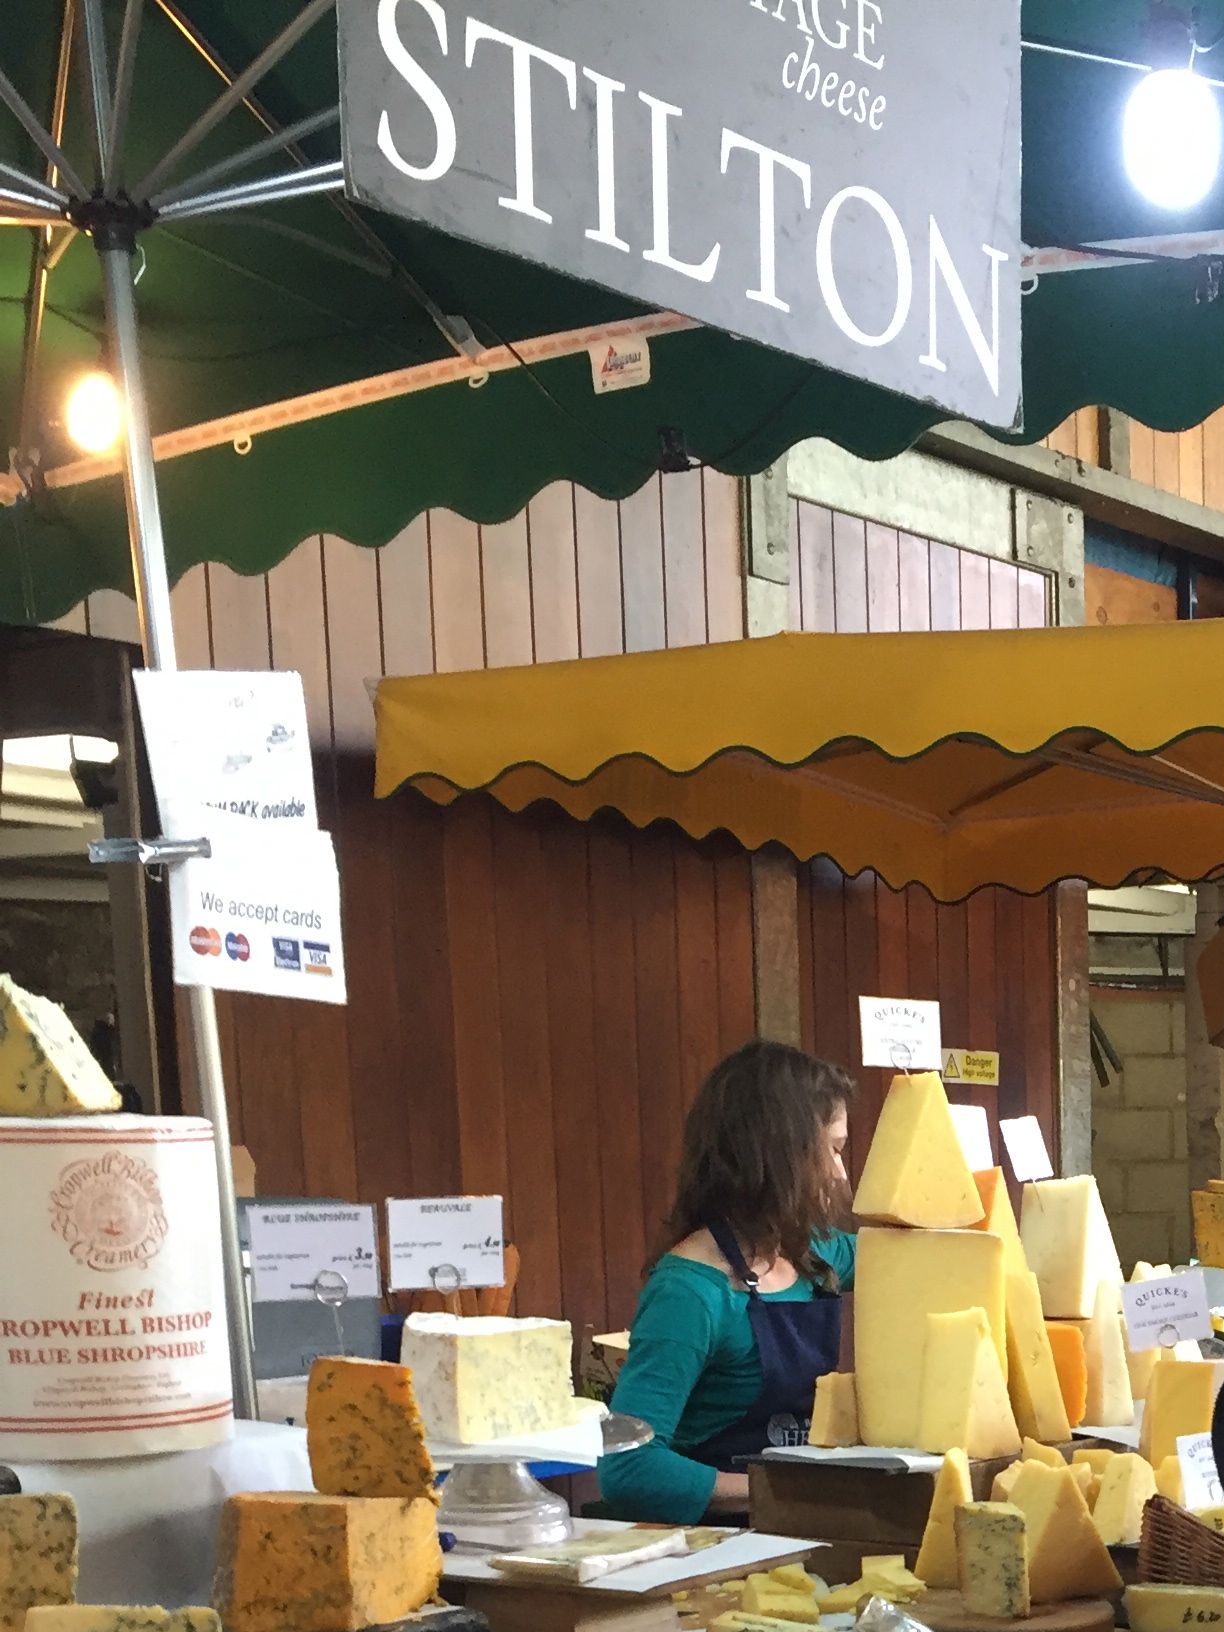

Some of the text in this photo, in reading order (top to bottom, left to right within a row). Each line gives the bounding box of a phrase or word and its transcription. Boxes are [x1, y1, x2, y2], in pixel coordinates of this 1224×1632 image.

[782, 36, 886, 131] cheese
[377, 0, 1009, 397] STILTON
[261, 797, 305, 820] available
[201, 891, 321, 930] We accept cards
[309, 950, 327, 965] VISA
[965, 1055, 993, 1068] Danger
[962, 1068, 995, 1079] High voltage
[78, 1288, 154, 1310] Finest
[1135, 1286, 1189, 1307] QUICKE'S
[0, 1311, 211, 1338] ROPWELL BISHOP
[7, 1340, 206, 1365] BLUE SHROPSHIRE
[1187, 1439, 1213, 1458] QUICK
